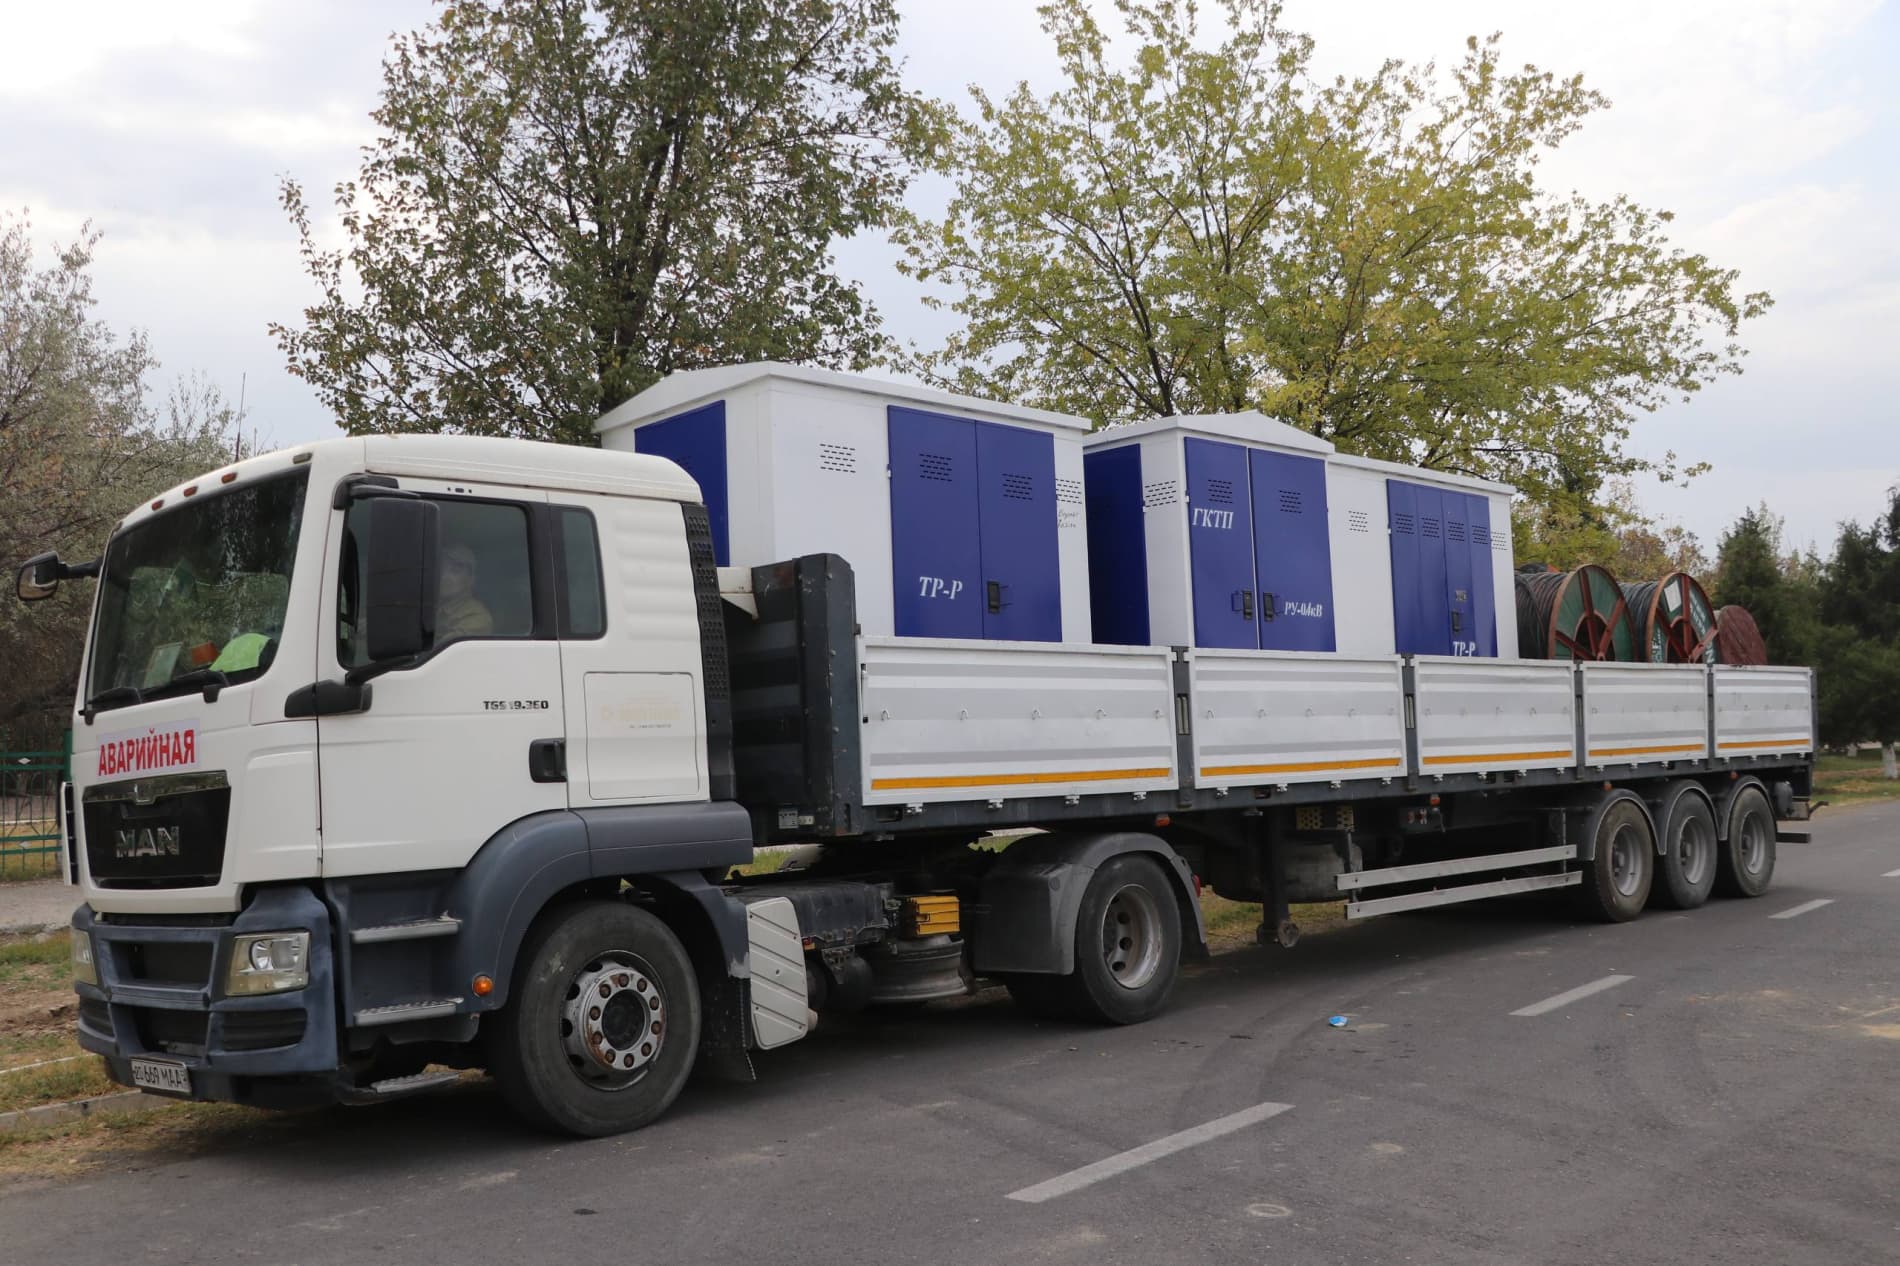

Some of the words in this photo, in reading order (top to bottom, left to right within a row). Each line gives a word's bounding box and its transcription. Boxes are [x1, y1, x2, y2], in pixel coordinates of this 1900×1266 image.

[1192, 508, 1234, 529] ГКТП
[98, 727, 196, 776] АВАРИЙНАЯ
[115, 826, 180, 858] MAN
